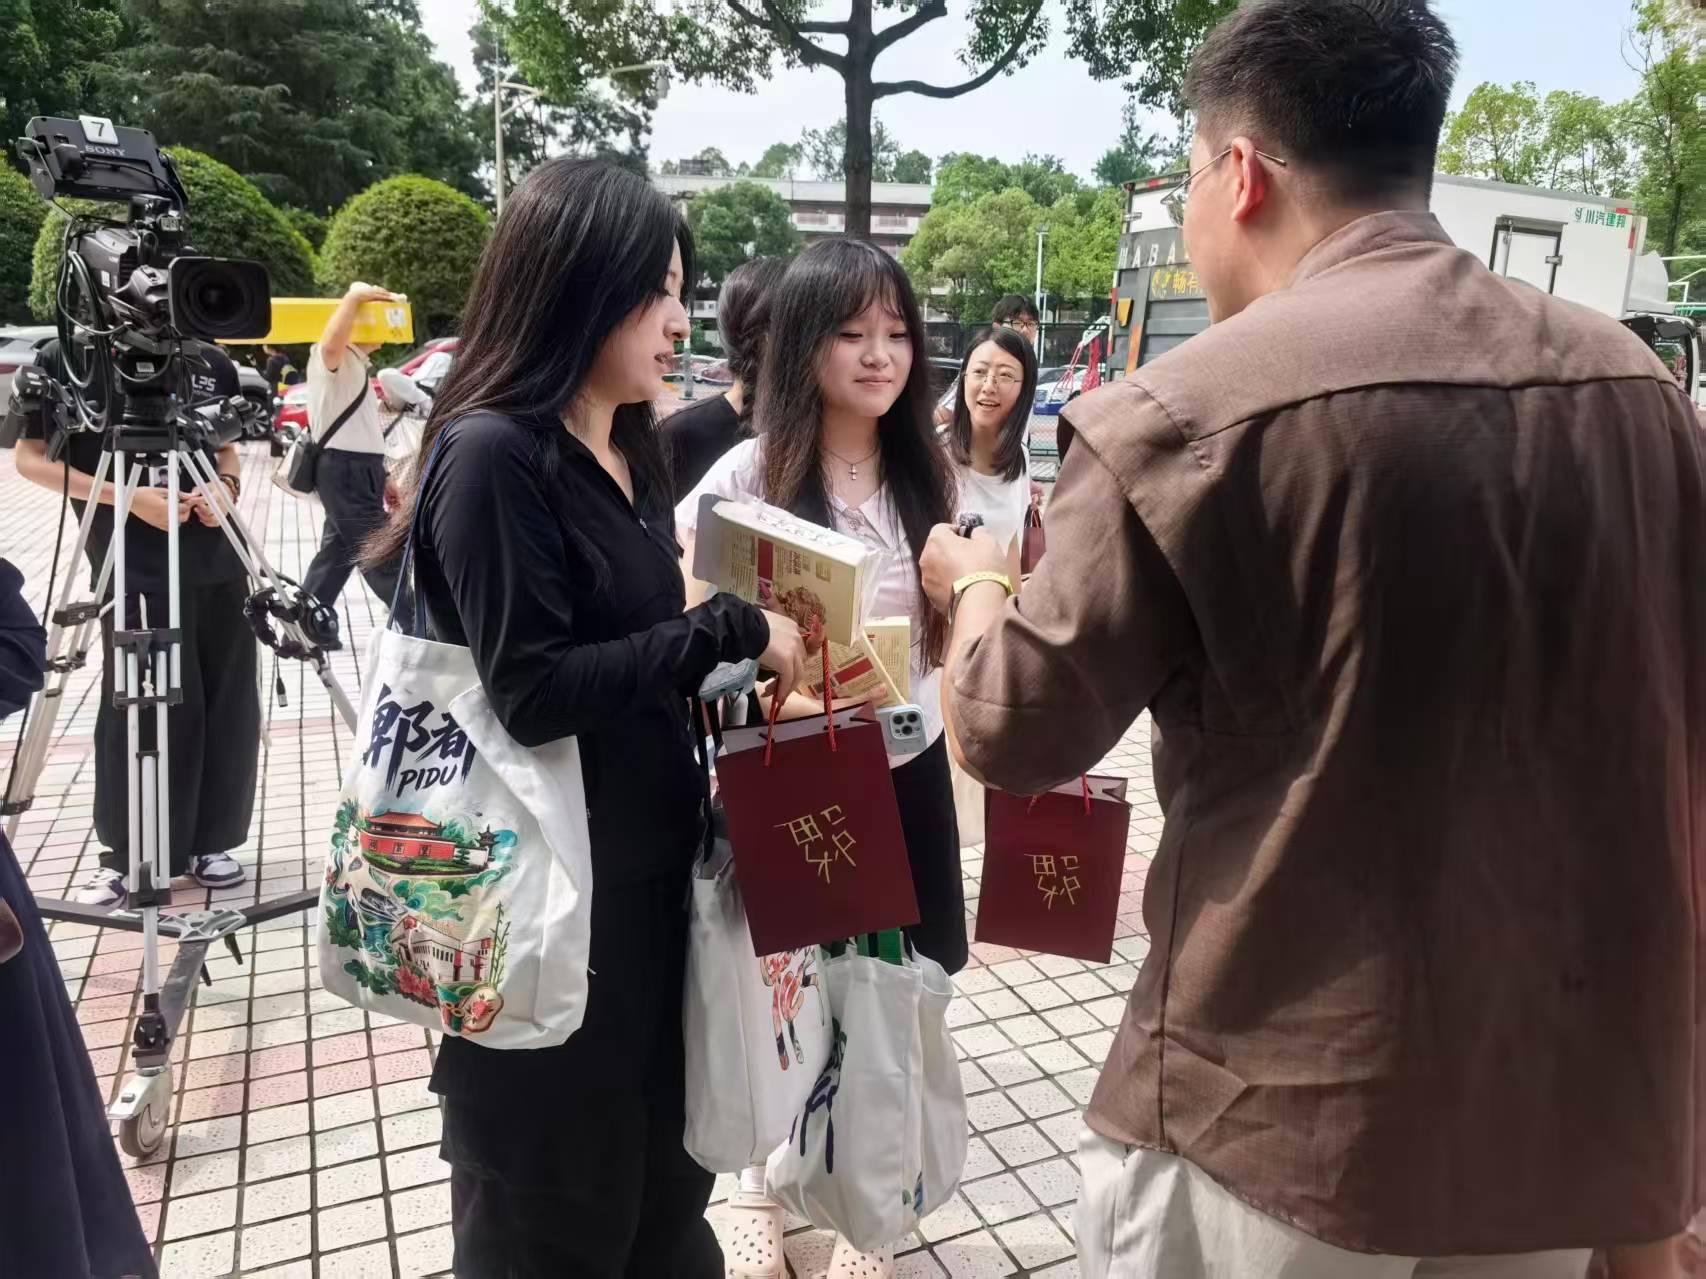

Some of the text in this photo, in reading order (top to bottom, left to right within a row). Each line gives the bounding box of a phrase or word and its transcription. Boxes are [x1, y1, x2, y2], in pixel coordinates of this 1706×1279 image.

[91, 120, 105, 137] 7
[84, 144, 126, 156] SONY
[395, 764, 459, 799] PIDU
